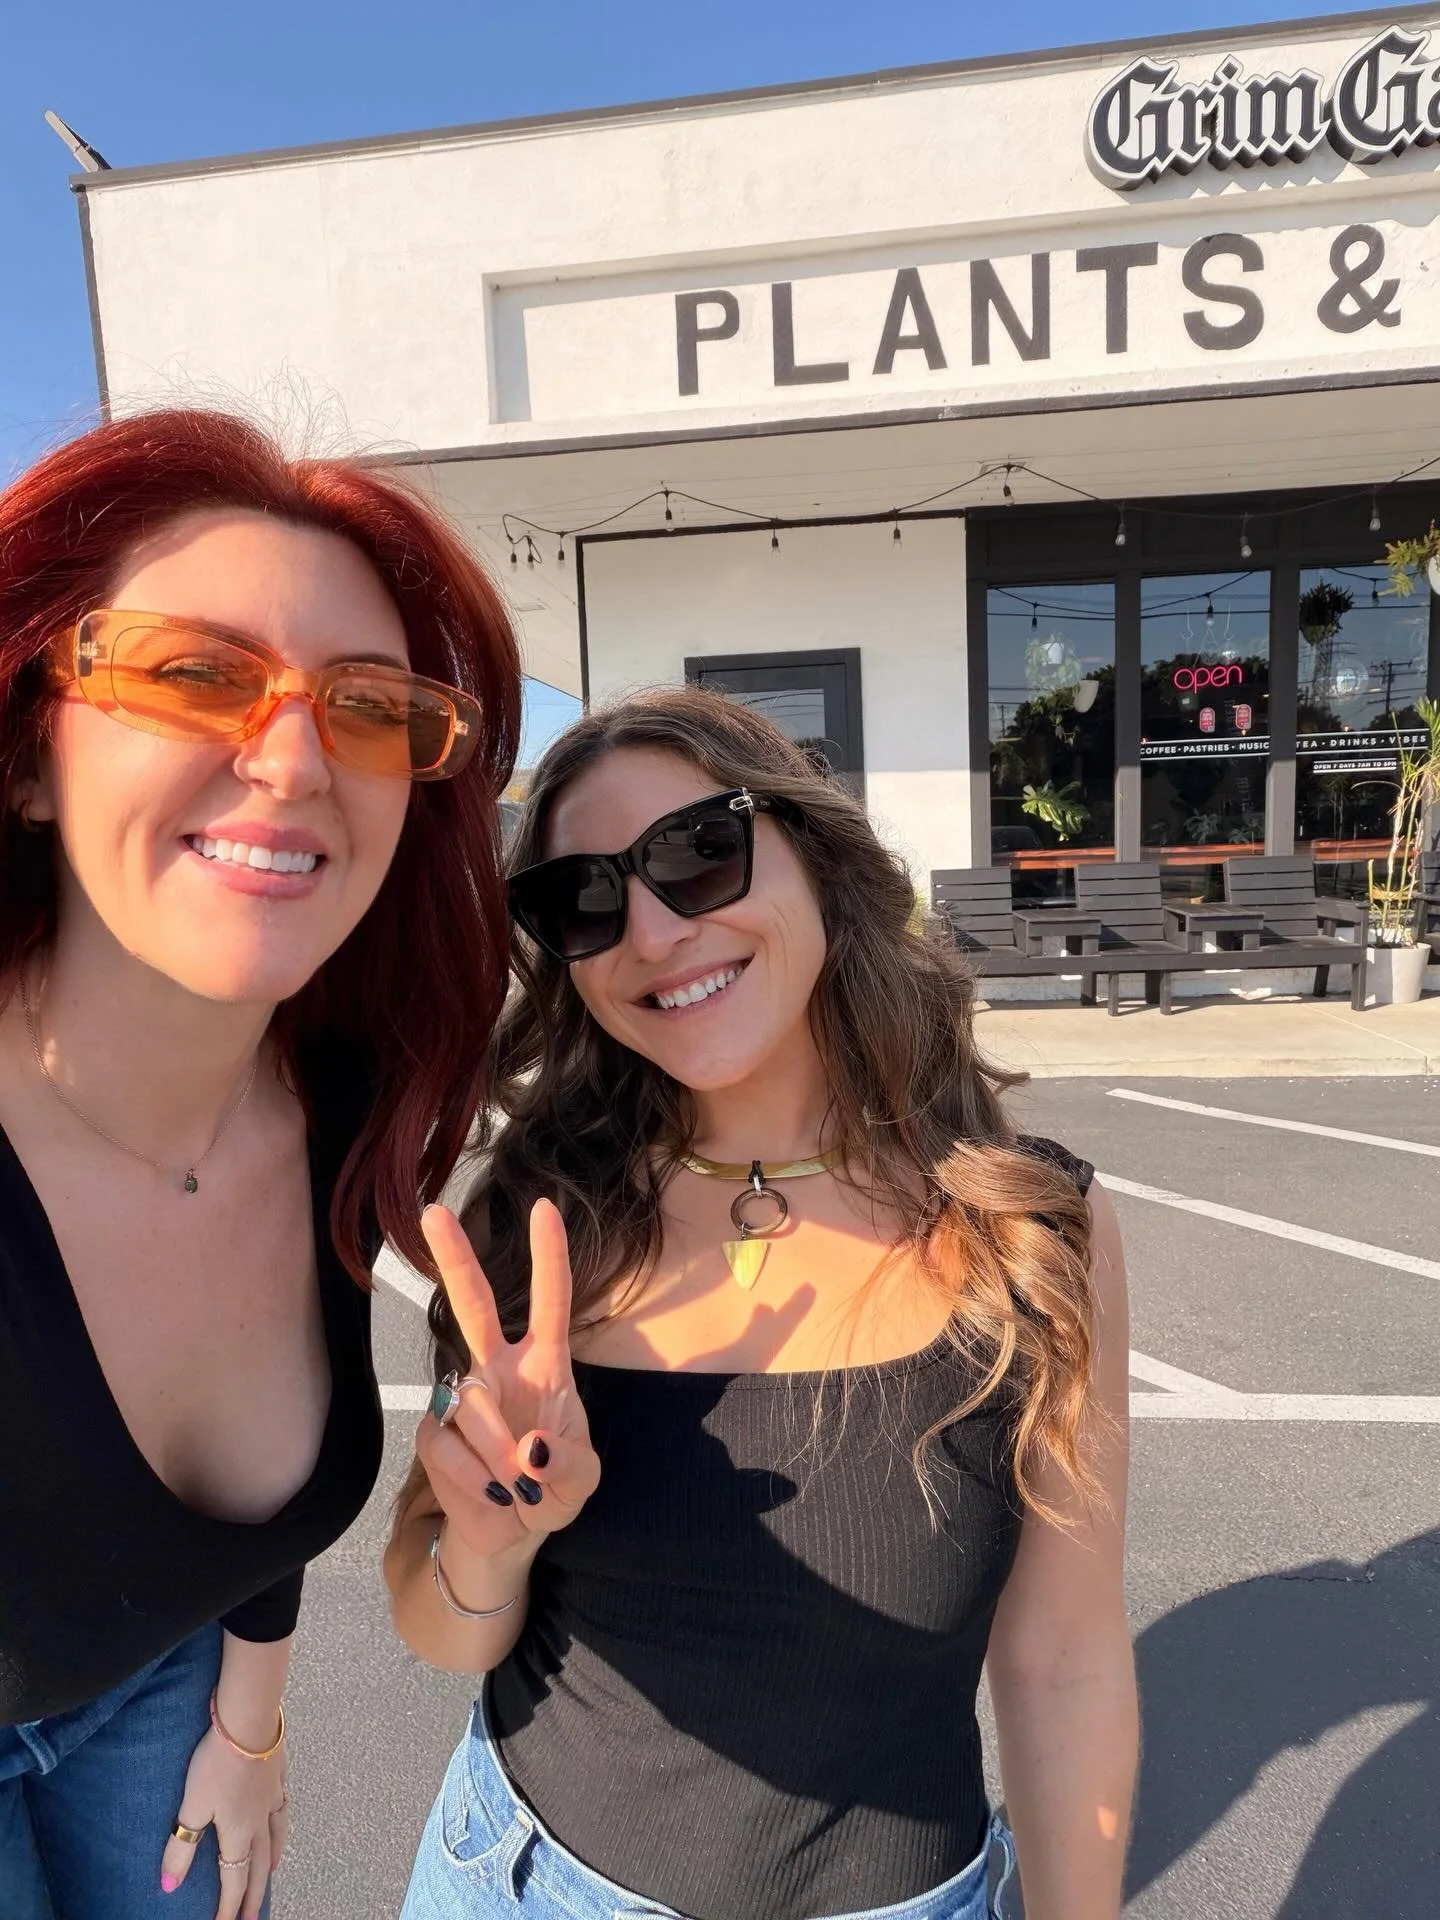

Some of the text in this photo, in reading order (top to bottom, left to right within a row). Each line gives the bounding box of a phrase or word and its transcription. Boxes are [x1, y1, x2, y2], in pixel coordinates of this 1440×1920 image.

[1089, 55, 1330, 182] Grim
[675, 224, 1401, 396] PLANTS &
[1174, 665, 1243, 694] open
[1140, 742, 1270, 755] COFFEE PASTRIES MUSIC
[1330, 737, 1377, 747] DRINKS
[1389, 735, 1427, 744] VBES
